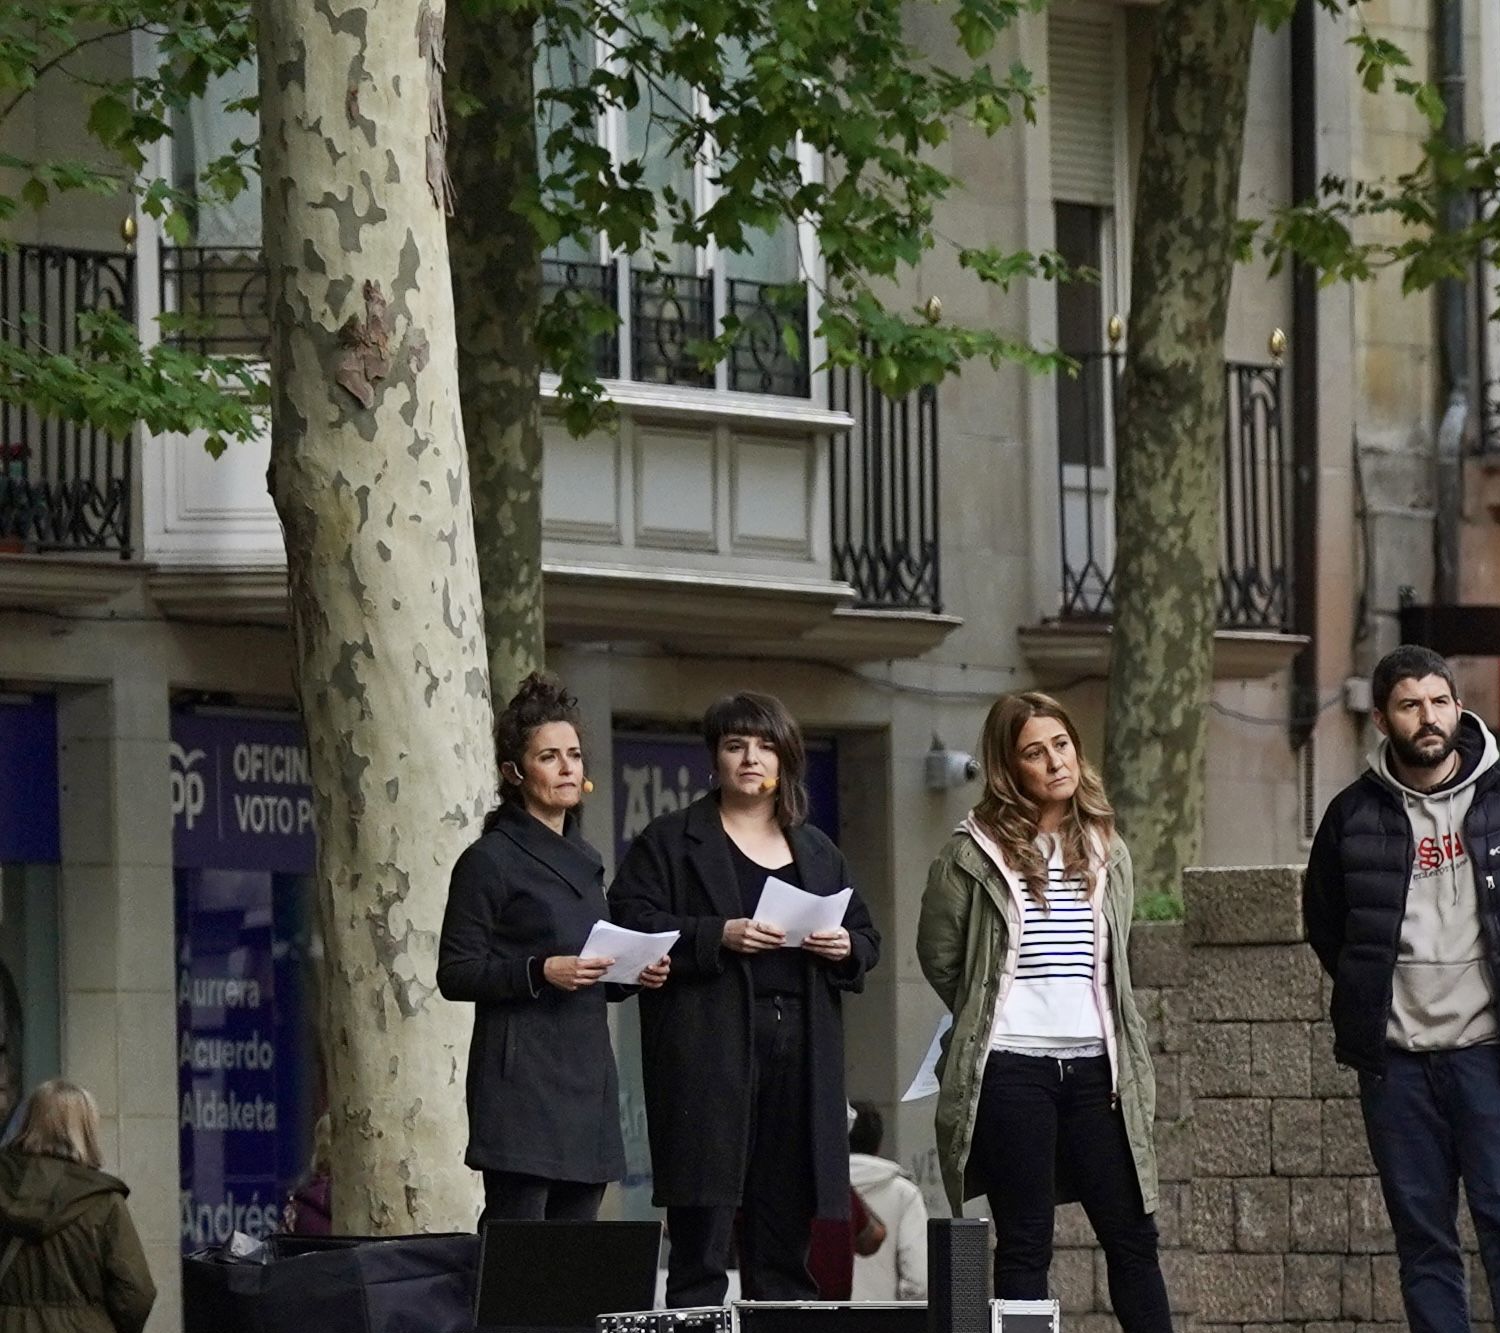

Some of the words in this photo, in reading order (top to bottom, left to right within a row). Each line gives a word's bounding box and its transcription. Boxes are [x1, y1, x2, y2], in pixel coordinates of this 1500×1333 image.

[233, 743, 312, 785] OFICIN
[234, 795, 294, 834] VOTO
[297, 798, 316, 835] P
[180, 969, 261, 1008] Aurrera
[181, 1030, 274, 1070] Acuerdo
[181, 1090, 277, 1130] Aldaketa
[181, 1190, 278, 1243] Andrés
